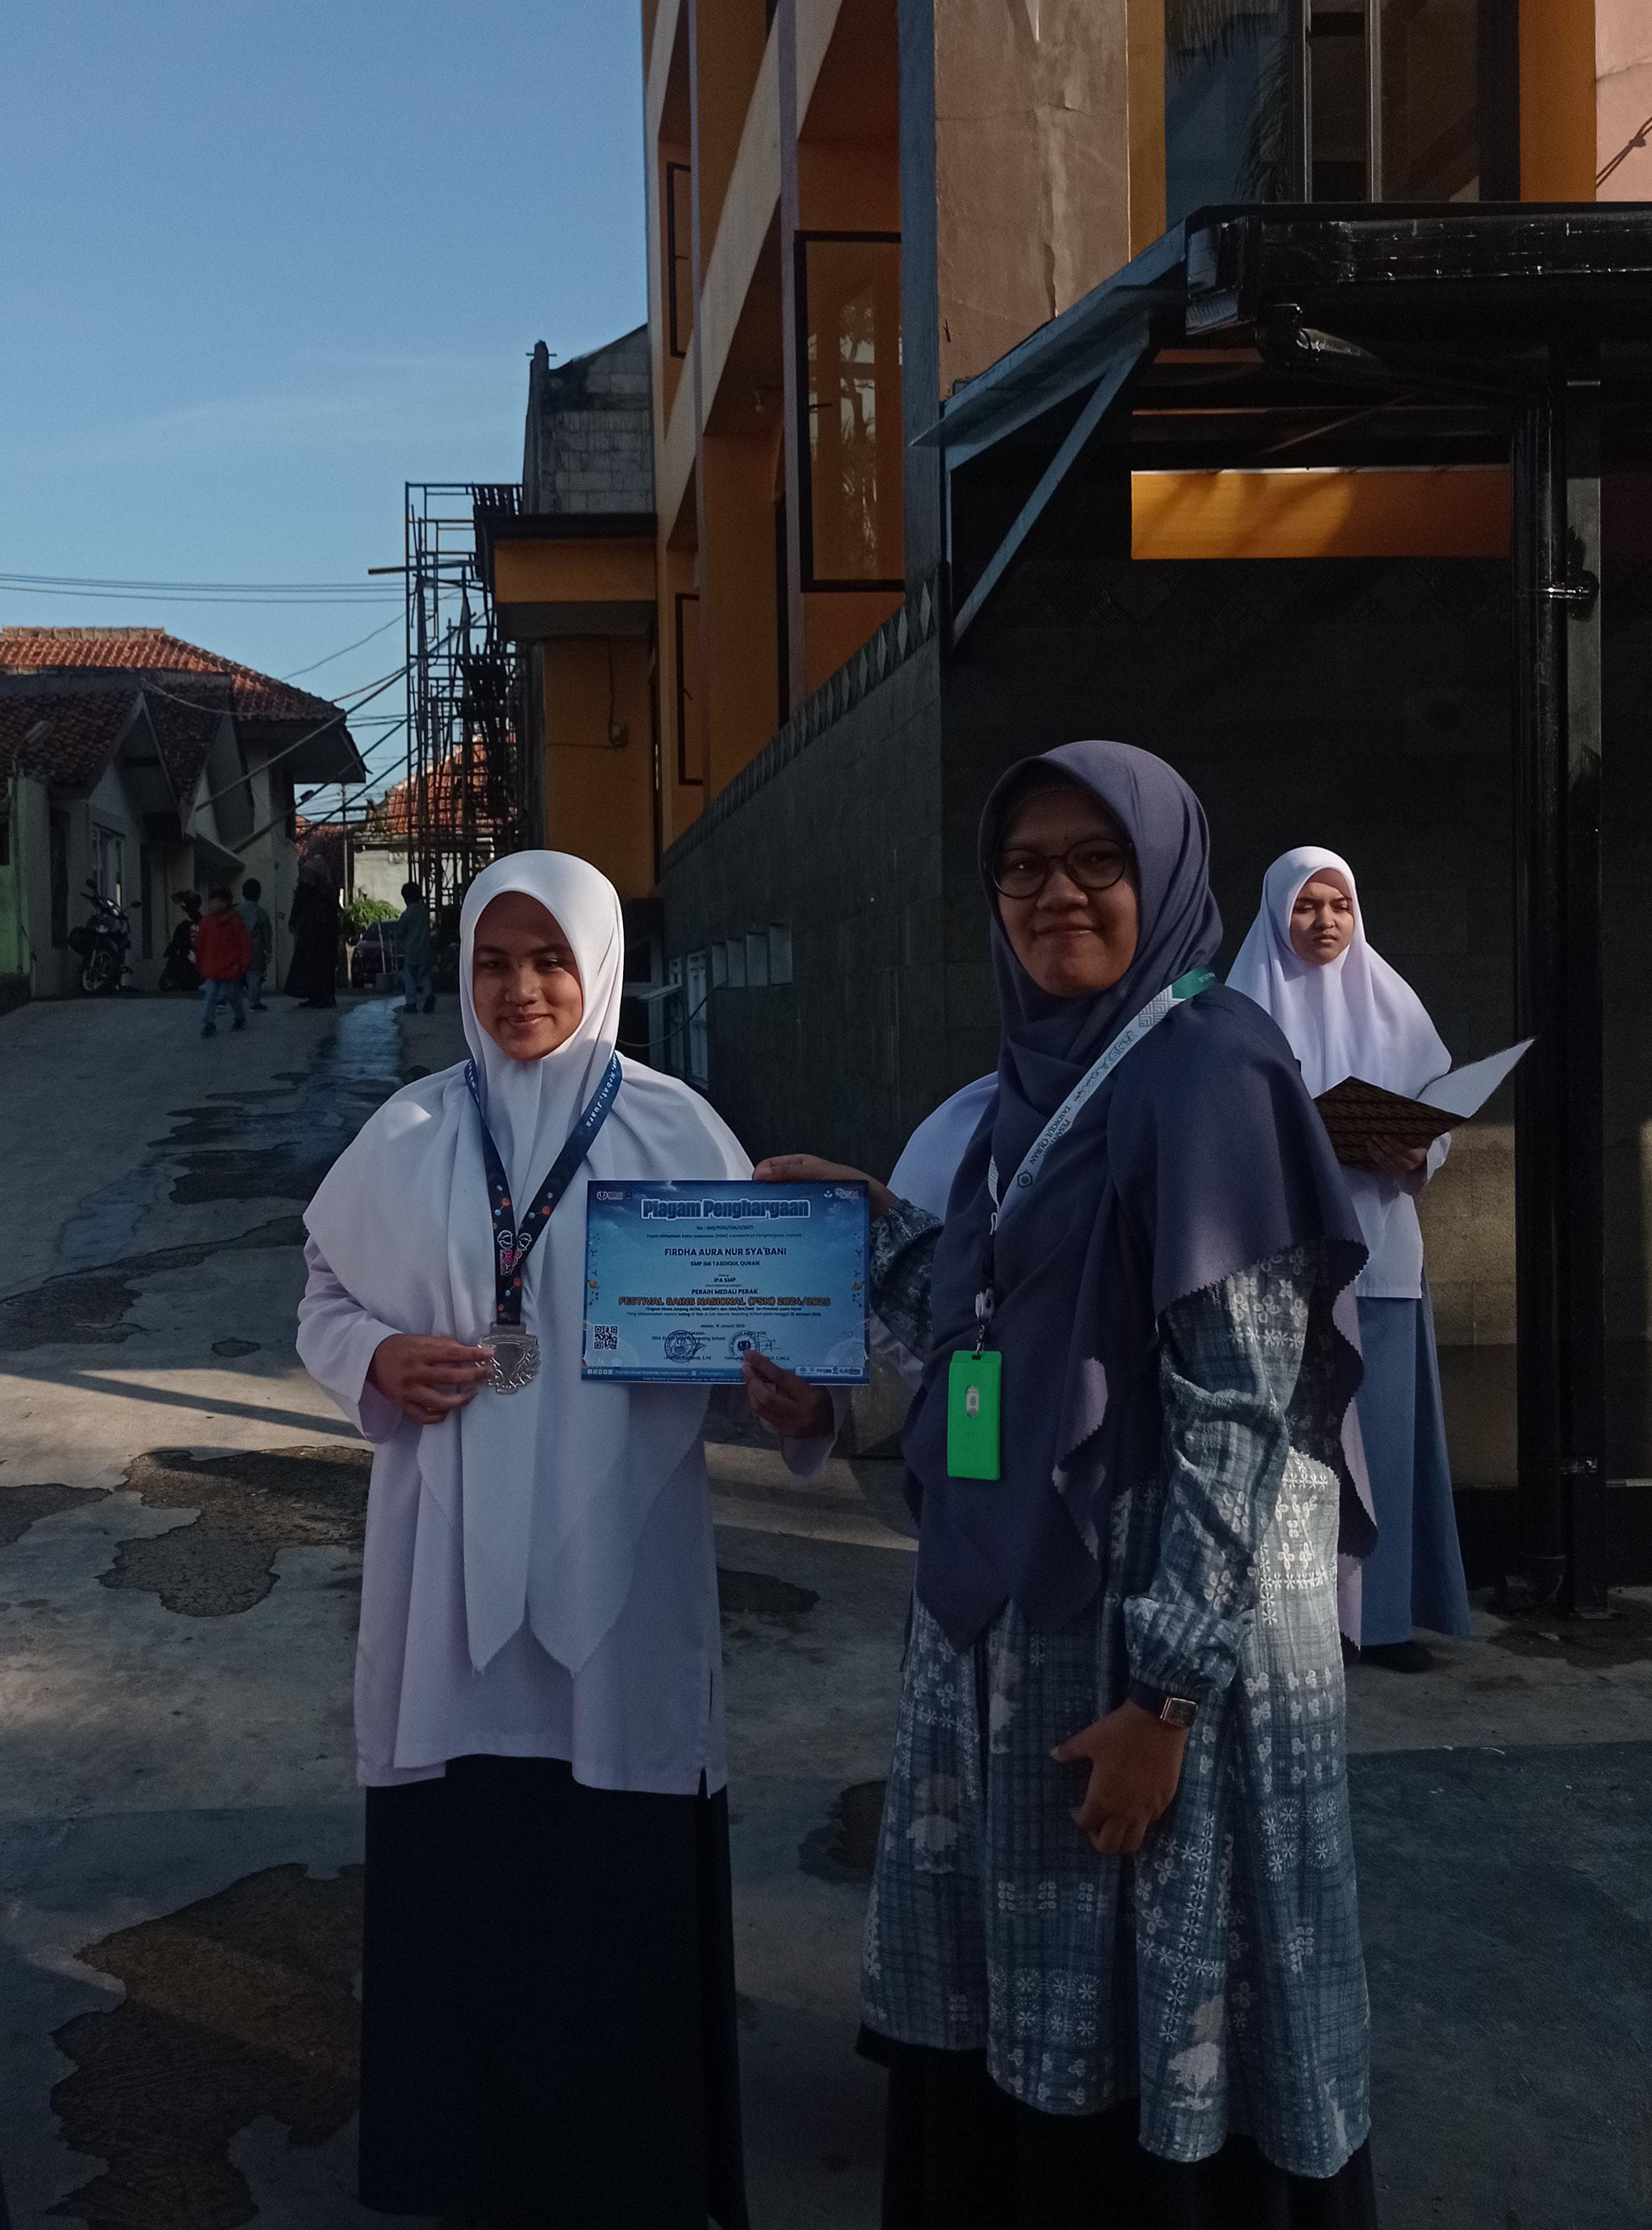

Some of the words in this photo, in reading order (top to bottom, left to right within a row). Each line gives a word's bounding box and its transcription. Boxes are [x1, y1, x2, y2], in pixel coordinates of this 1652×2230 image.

[585, 1101, 604, 1128] Juara
[1048, 1106, 1070, 1138] TASDIQUL
[1030, 1139, 1049, 1164] QURAN
[642, 1199, 701, 1219] Piagam
[701, 1199, 810, 1219] Penghargaan
[745, 1247, 787, 1255] SYA'BANI
[618, 1297, 665, 1307] FESTIVAL
[666, 1297, 695, 1307] SAINS
[697, 1297, 746, 1307] NASIONAL
[747, 1296, 775, 1307] (FSN)
[777, 1297, 831, 1307] 2024/2025
